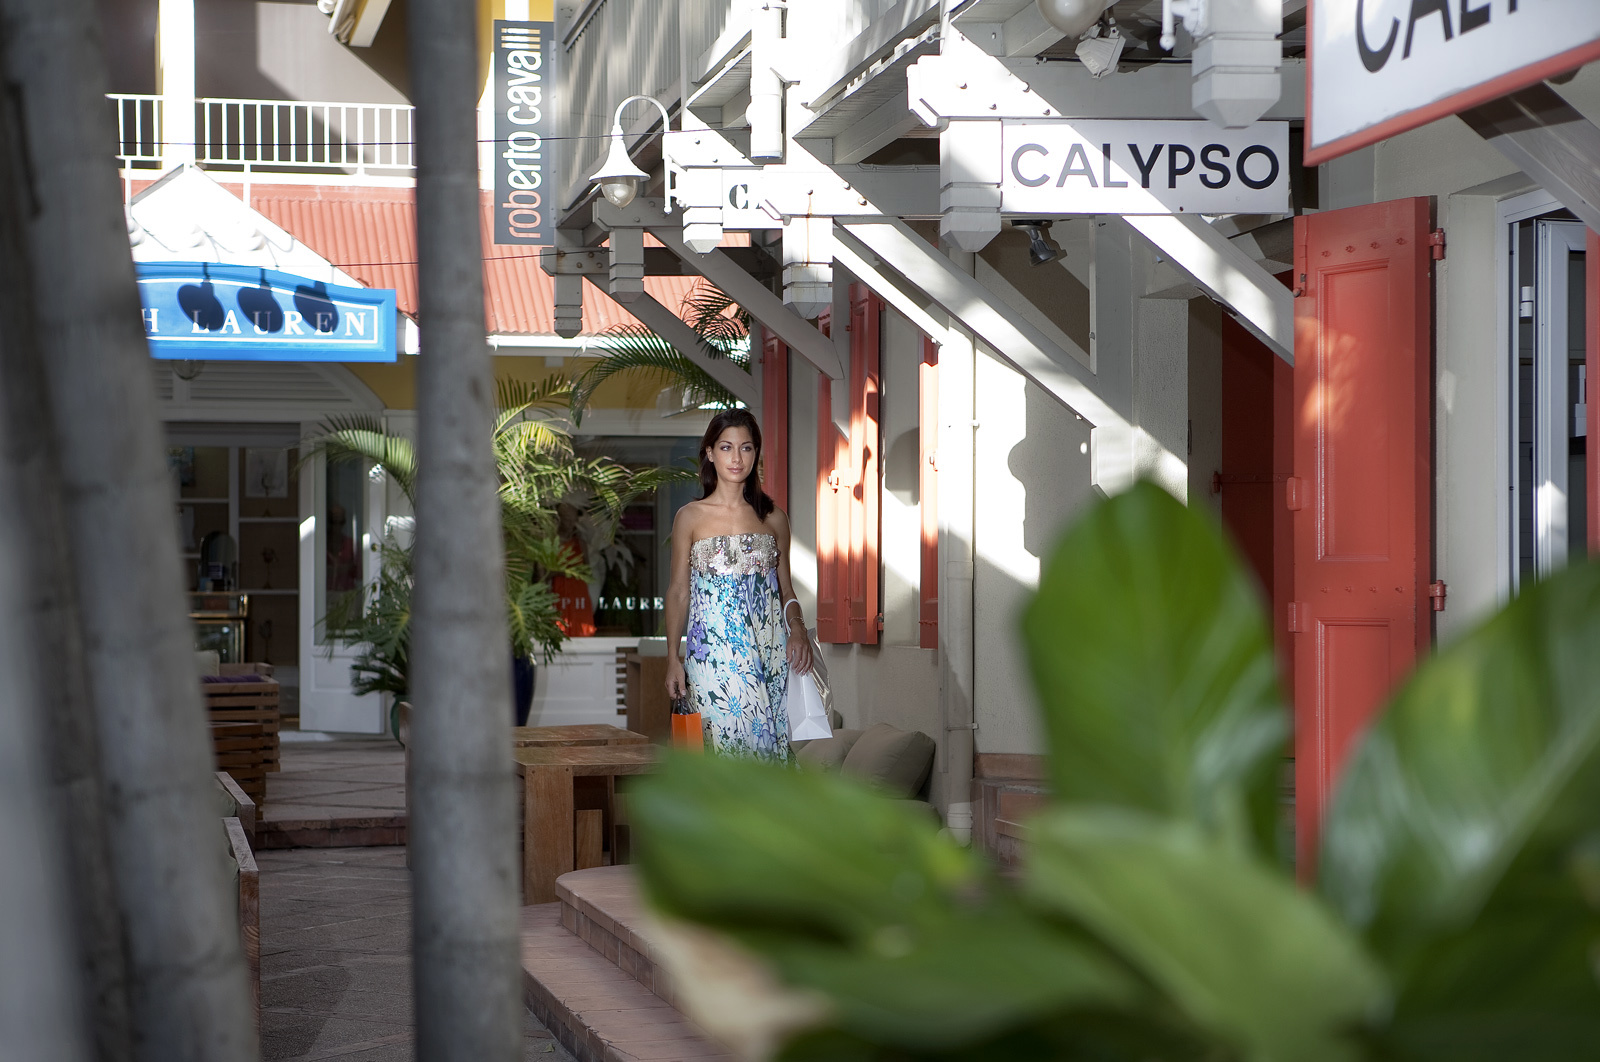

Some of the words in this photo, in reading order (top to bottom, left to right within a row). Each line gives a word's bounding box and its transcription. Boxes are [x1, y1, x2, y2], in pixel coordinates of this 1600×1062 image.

[501, 28, 542, 125] cavalli
[502, 131, 542, 238] roberto
[1011, 143, 1280, 190] CALYPSO
[729, 184, 761, 209] C
[191, 309, 366, 336] LAUREN
